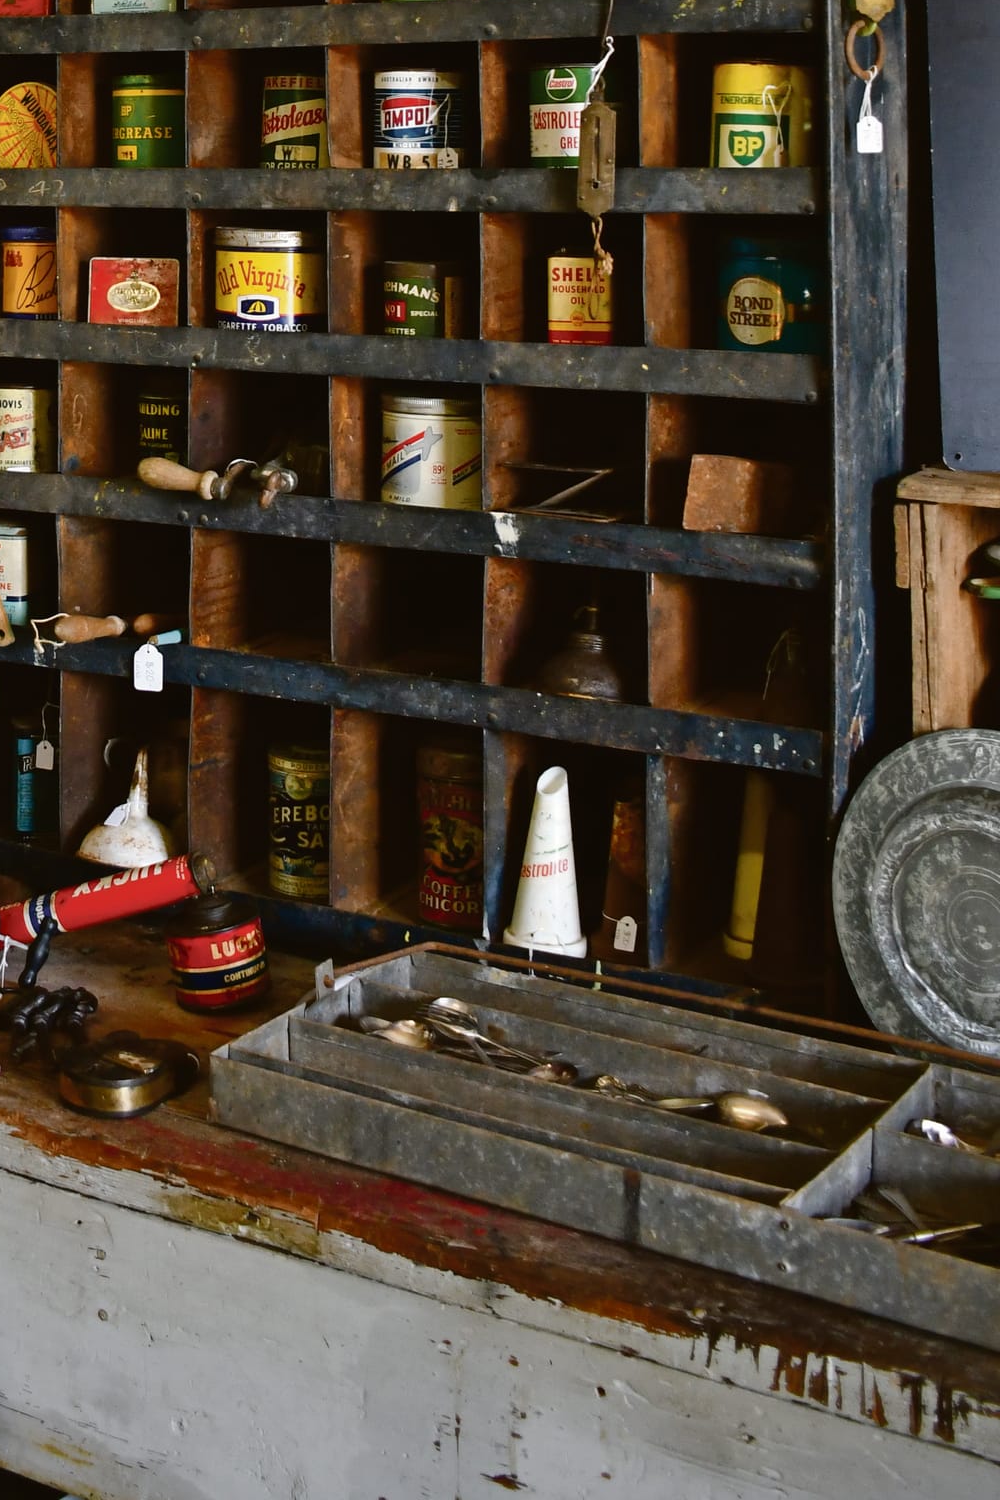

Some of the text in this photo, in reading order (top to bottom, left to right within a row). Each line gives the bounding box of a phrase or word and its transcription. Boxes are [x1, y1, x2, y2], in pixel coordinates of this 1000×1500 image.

[263, 76, 325, 89] AKEFIEL
[549, 79, 575, 88] Castrol
[384, 107, 433, 129] AMPOL
[533, 110, 581, 130] CASTROLE
[560, 136, 579, 150] GRE
[732, 135, 763, 158] BP
[217, 259, 306, 300] Old Virginia
[570, 296, 586, 306] OIL
[733, 295, 774, 311] BOND
[410, 309, 439, 317] SPECIAL
[729, 311, 783, 328] STREET
[261, 322, 308, 333] TOBACCO
[138, 403, 181, 417] ULDING
[272, 803, 330, 825] EREBO
[296, 830, 325, 850] SA
[71, 863, 164, 899] LUCKY
[418, 890, 480, 915] CHICOR
